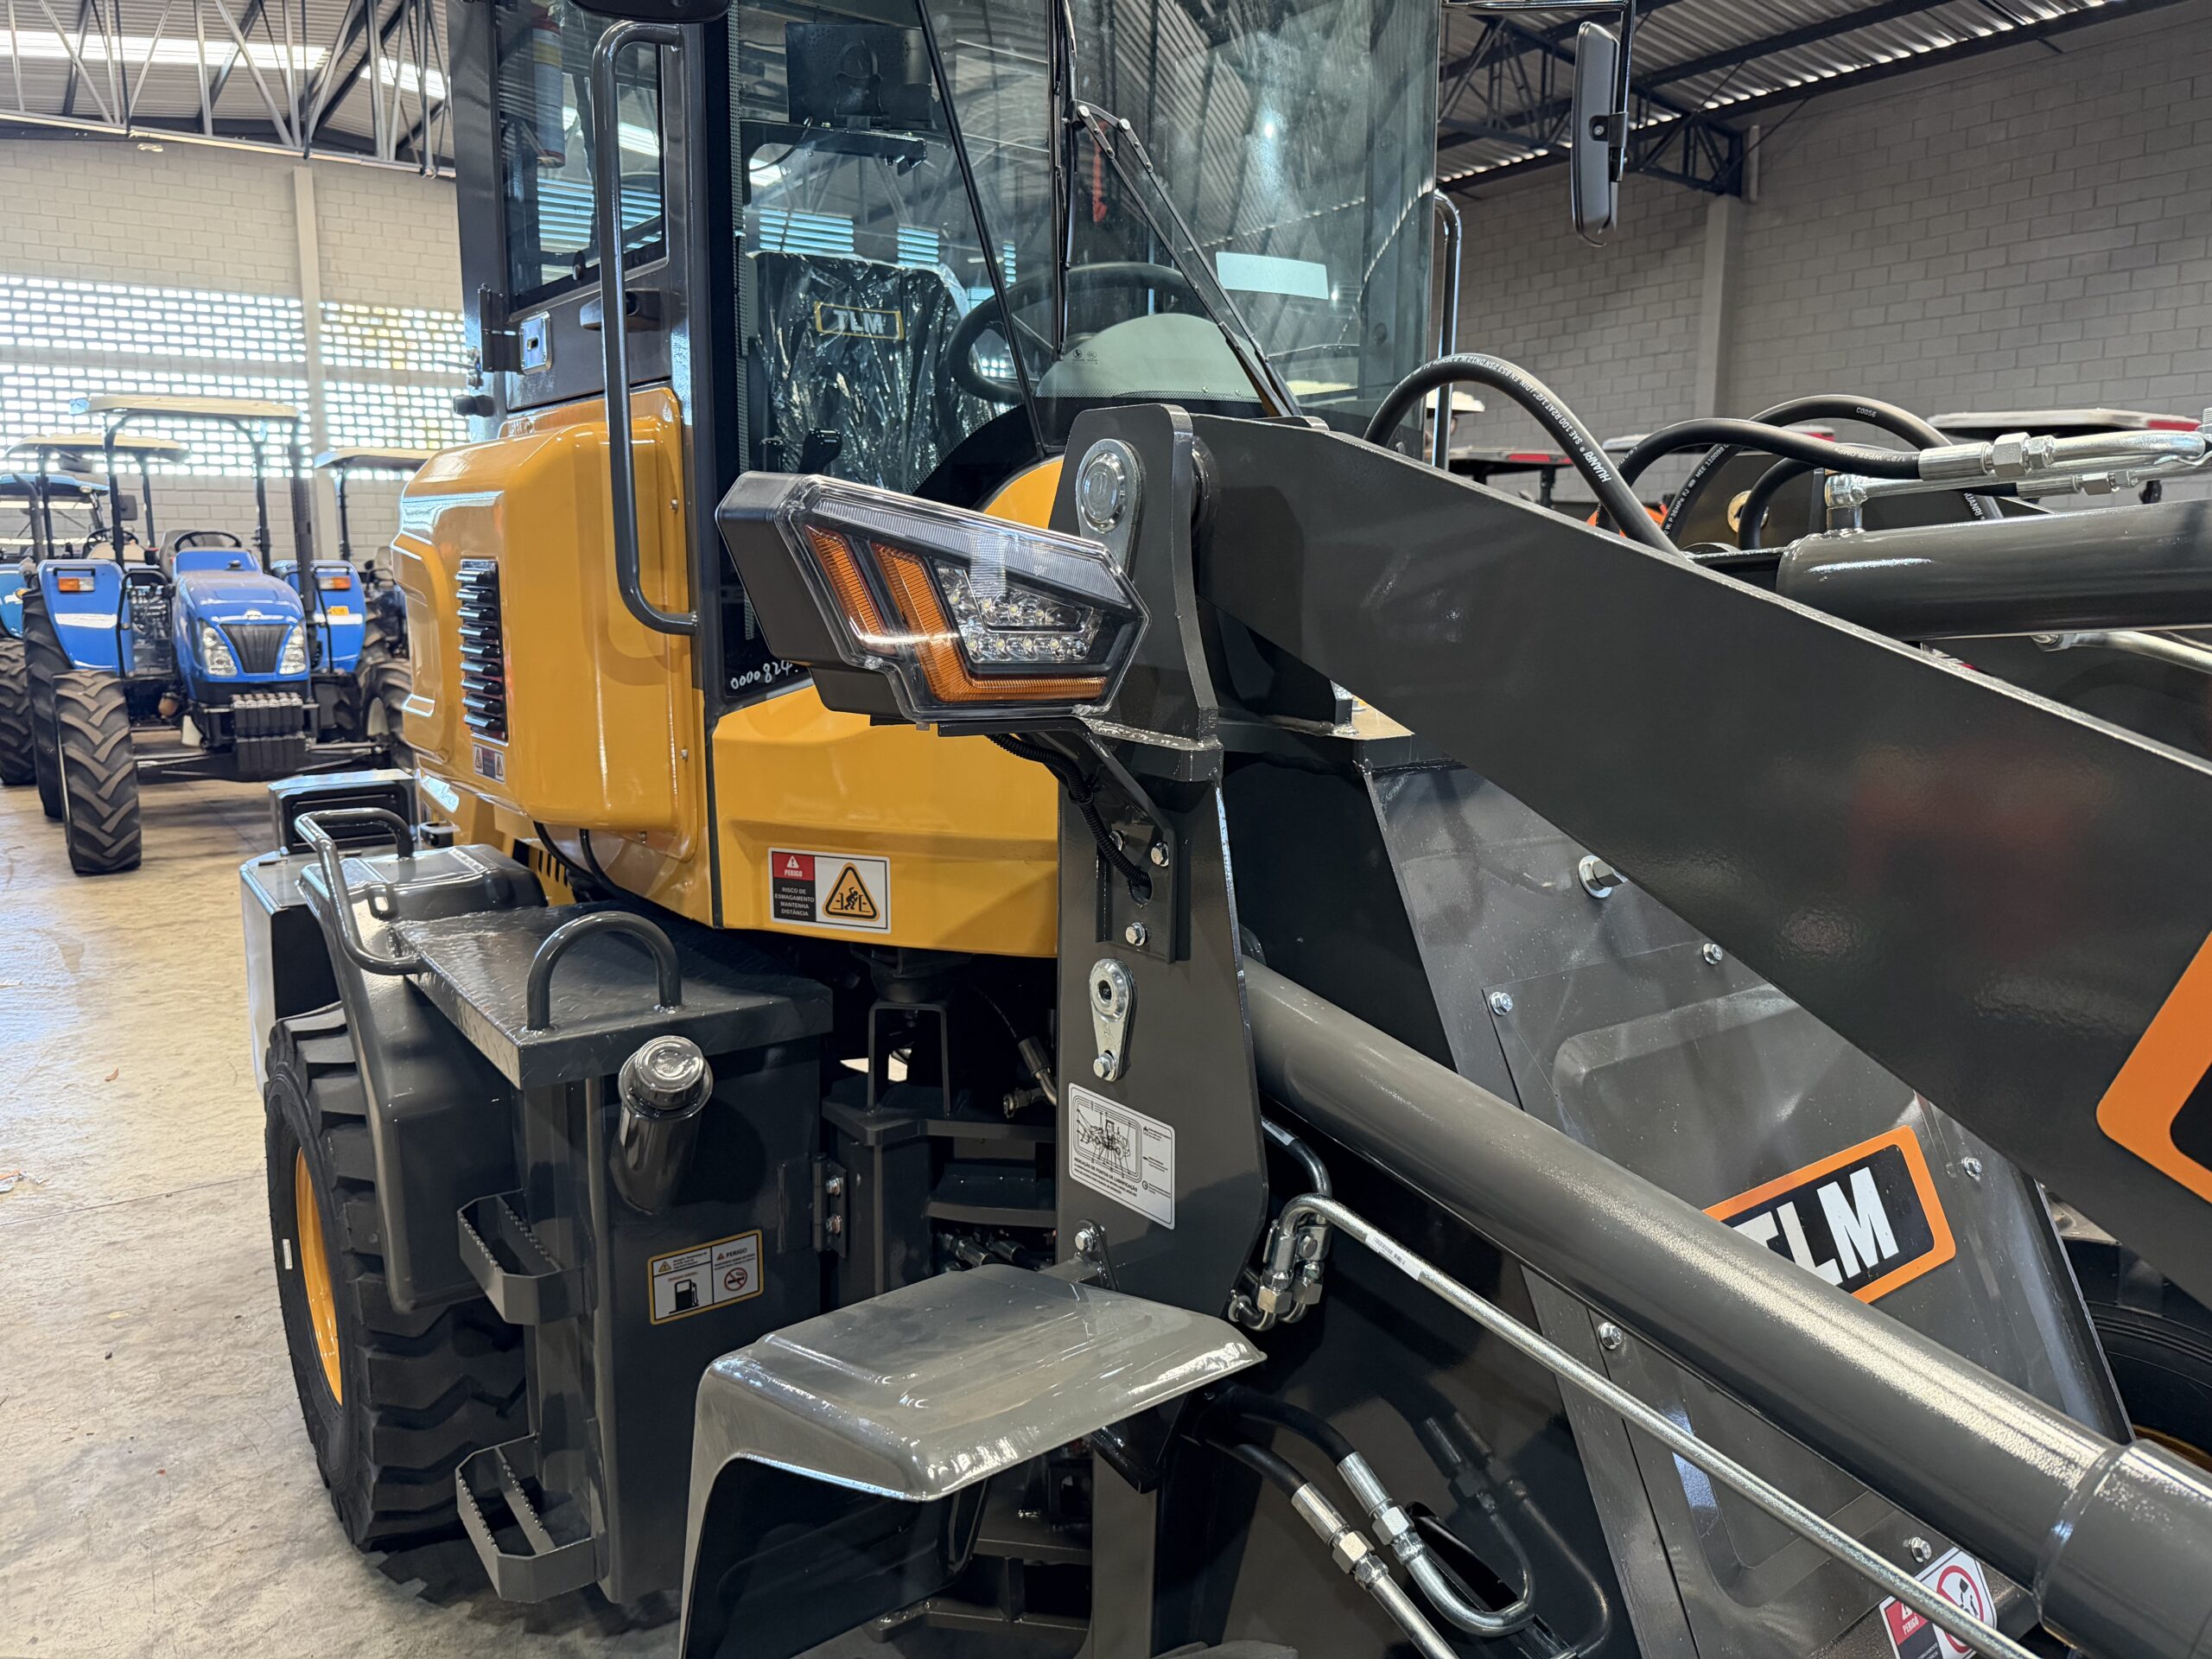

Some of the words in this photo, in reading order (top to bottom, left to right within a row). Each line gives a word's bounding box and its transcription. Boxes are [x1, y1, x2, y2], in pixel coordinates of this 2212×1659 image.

[833, 309, 884, 334] TLM
[1544, 403, 1563, 420] R2AT
[1558, 417, 1573, 432] 100
[1568, 429, 1583, 445] SAE
[1583, 451, 1612, 483] HUANRI
[784, 869, 803, 878] PERIGO
[774, 893, 815, 903] ESMAGAMENTO
[781, 908, 809, 917] DISTÂNCIA
[726, 1248, 747, 1258] PERIGO
[1902, 1616, 1920, 1635] PERIGO
